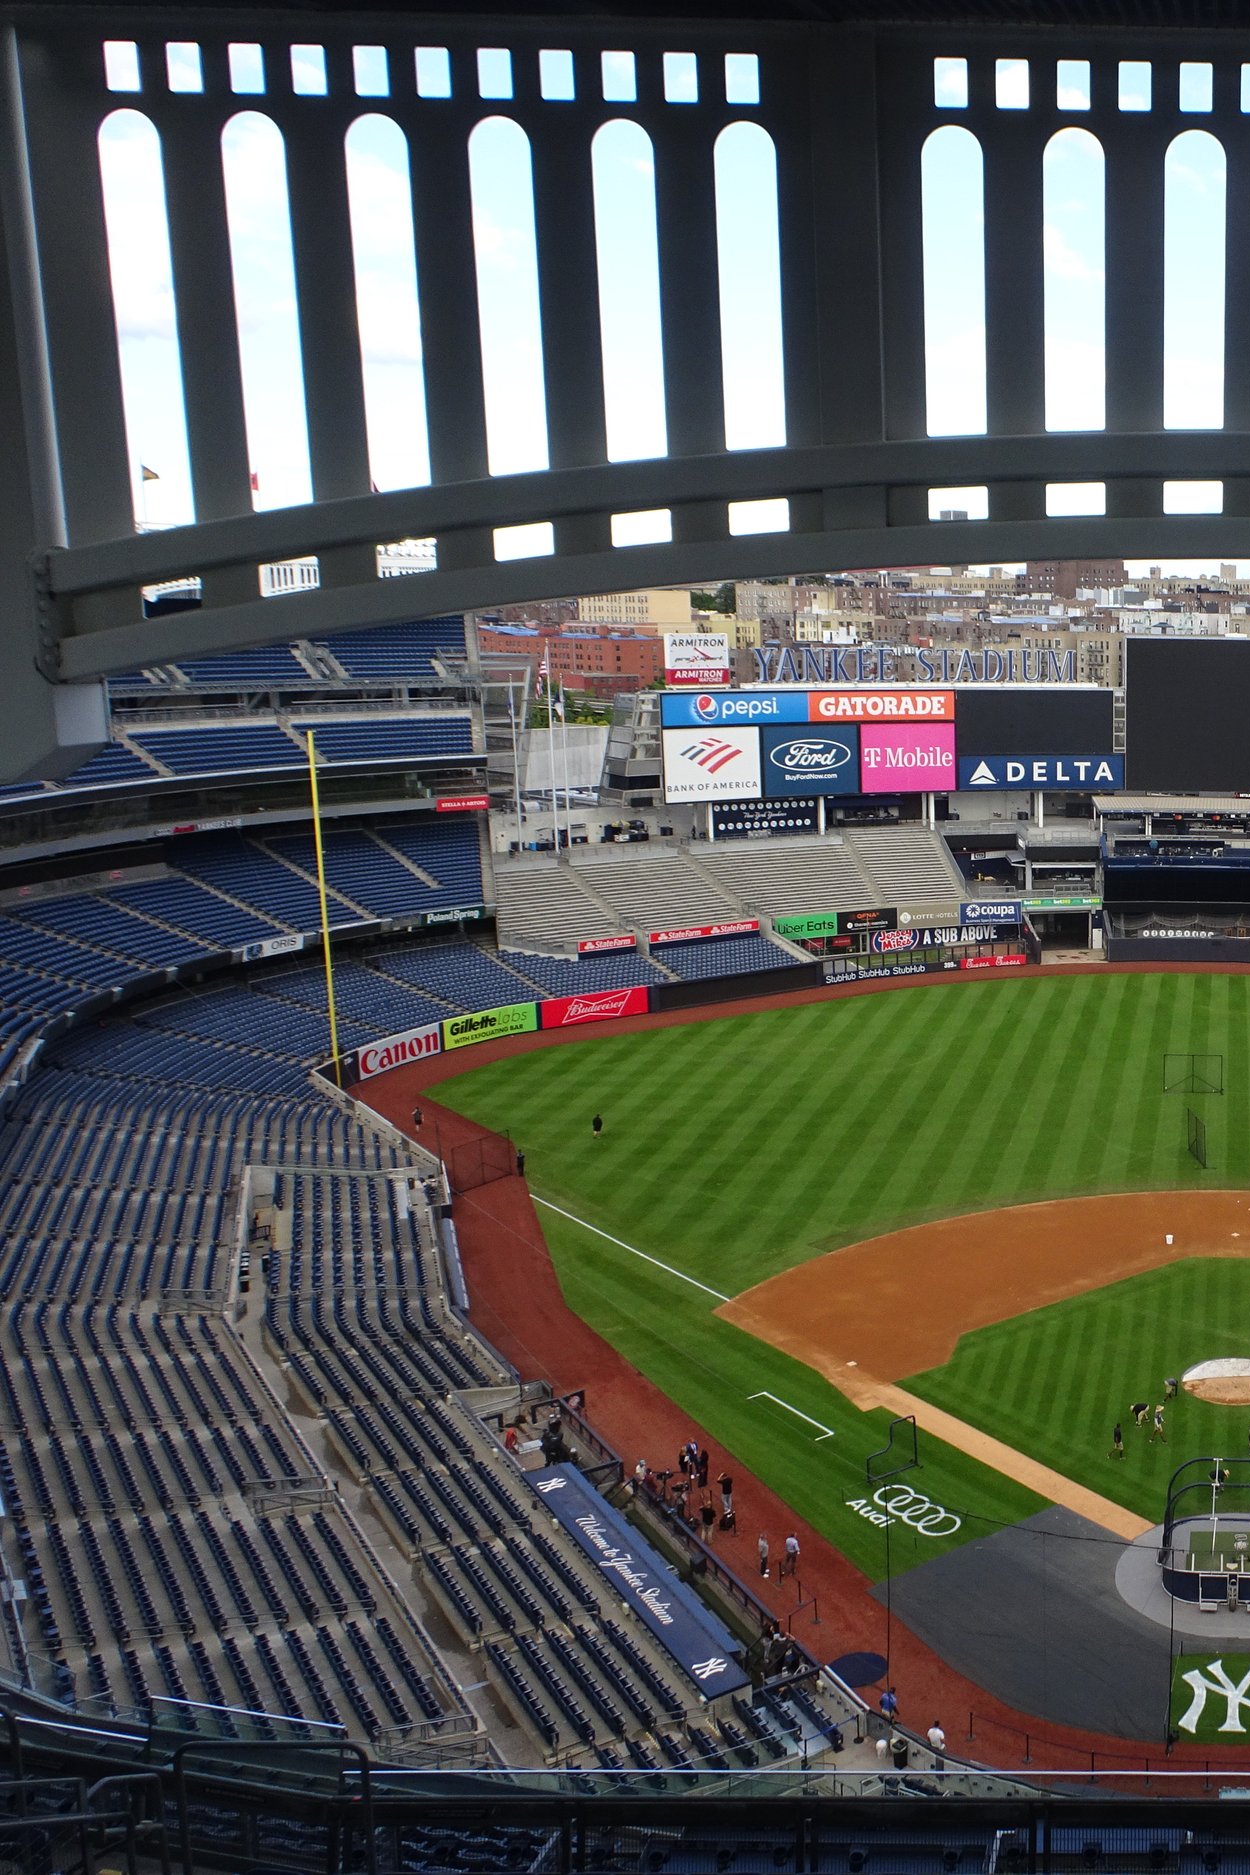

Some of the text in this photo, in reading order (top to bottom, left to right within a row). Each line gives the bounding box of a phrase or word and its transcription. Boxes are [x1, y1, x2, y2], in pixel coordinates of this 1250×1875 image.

[671, 638, 725, 646] ARMITRON
[753, 647, 1077, 683] YANKEE STADIUM
[674, 670, 723, 678] ARMITRON
[722, 698, 778, 718] pepsi
[818, 696, 945, 716] GATORADE
[785, 743, 836, 766] Ford
[884, 746, 953, 768] Mobile
[784, 773, 838, 781] BuyFordNow.com
[1006, 761, 1114, 782] DELTA
[667, 784, 696, 792] BANK
[712, 780, 758, 790] AMERICA
[426, 909, 480, 924] Poland Spring
[981, 906, 1015, 917] coupa
[778, 922, 805, 934] Uber
[807, 920, 834, 931] Eats
[923, 925, 998, 945] A SUB ABOVE
[271, 937, 297, 950] ORIS
[858, 968, 890, 979] StubHub
[892, 965, 925, 975] StubHub
[826, 973, 856, 984] StubHub
[568, 1000, 625, 1016] Budweiser
[450, 1008, 527, 1036] Gillette Labs
[454, 1036, 470, 1044] WITH
[470, 1028, 509, 1042] EXFOLIATING
[361, 1031, 439, 1075] Canon
[536, 1477, 567, 1492] NY
[846, 1498, 896, 1528] Audi
[575, 1514, 674, 1626] Welcome to Yankee Stadium
[692, 1657, 728, 1679] NY
